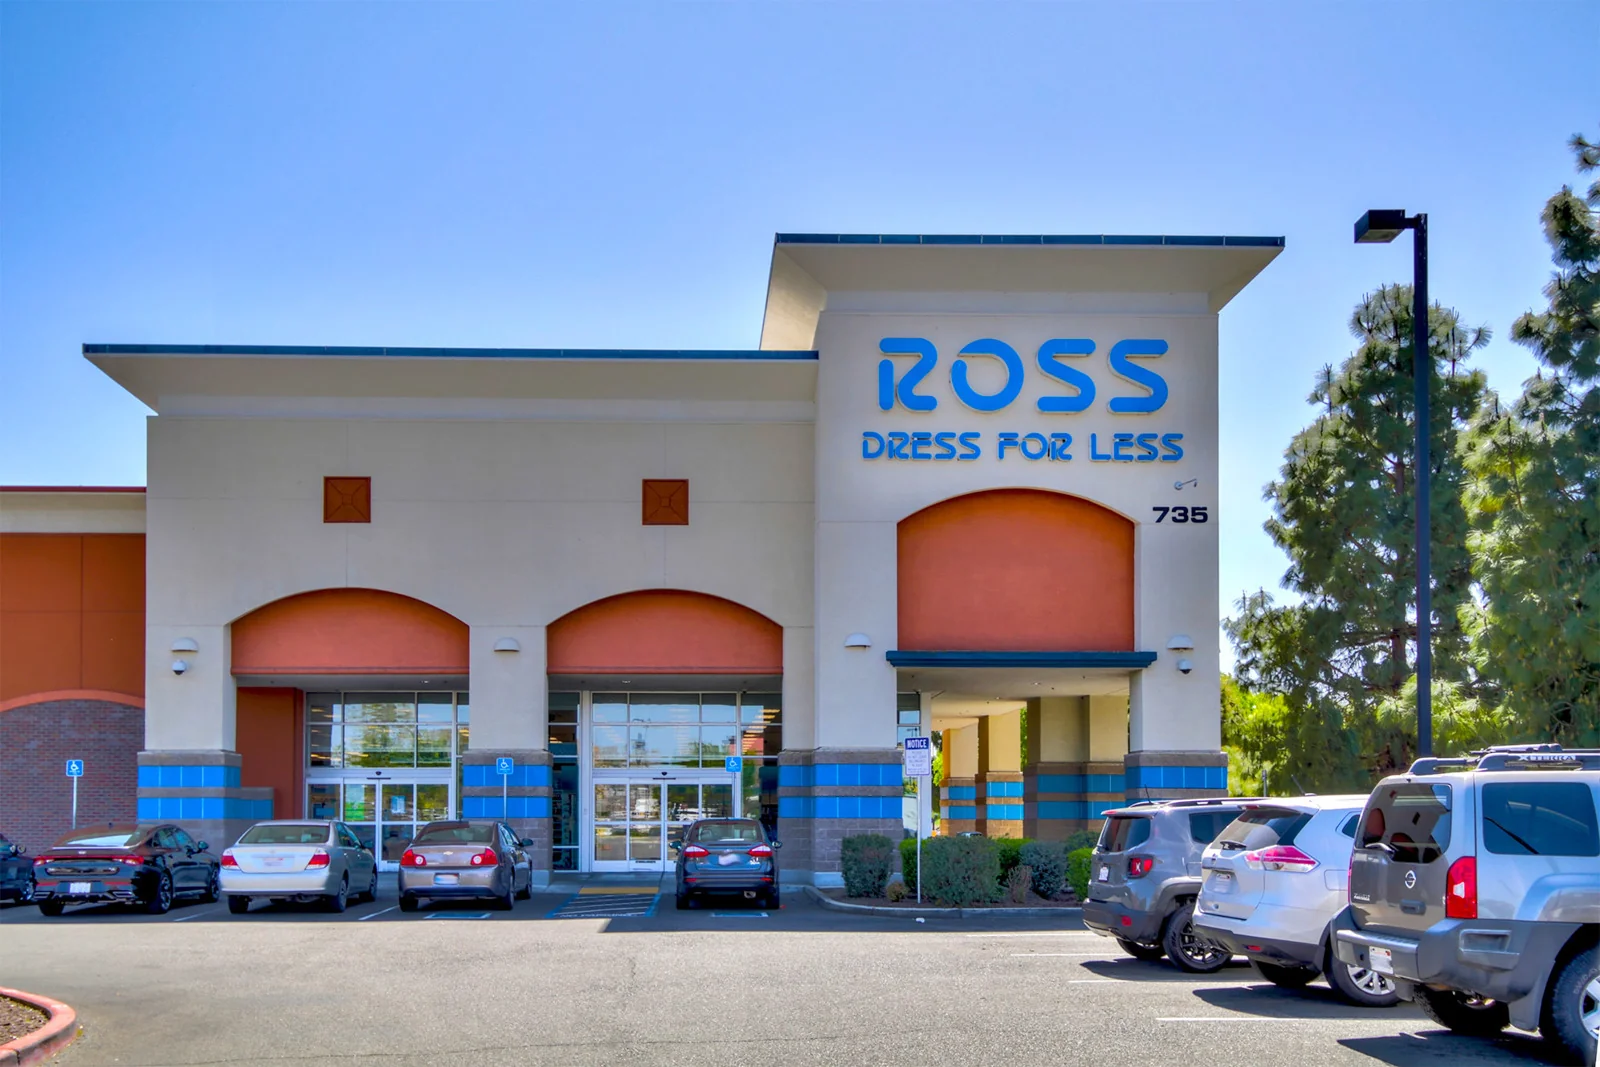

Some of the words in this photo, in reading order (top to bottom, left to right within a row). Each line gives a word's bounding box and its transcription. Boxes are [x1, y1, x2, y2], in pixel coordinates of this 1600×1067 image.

[878, 337, 1169, 413] ROSS
[862, 431, 982, 460] DRESS
[998, 432, 1073, 461] FOR
[1090, 432, 1184, 462] LESS
[1152, 506, 1209, 524] 735
[907, 739, 927, 748] NOTICE
